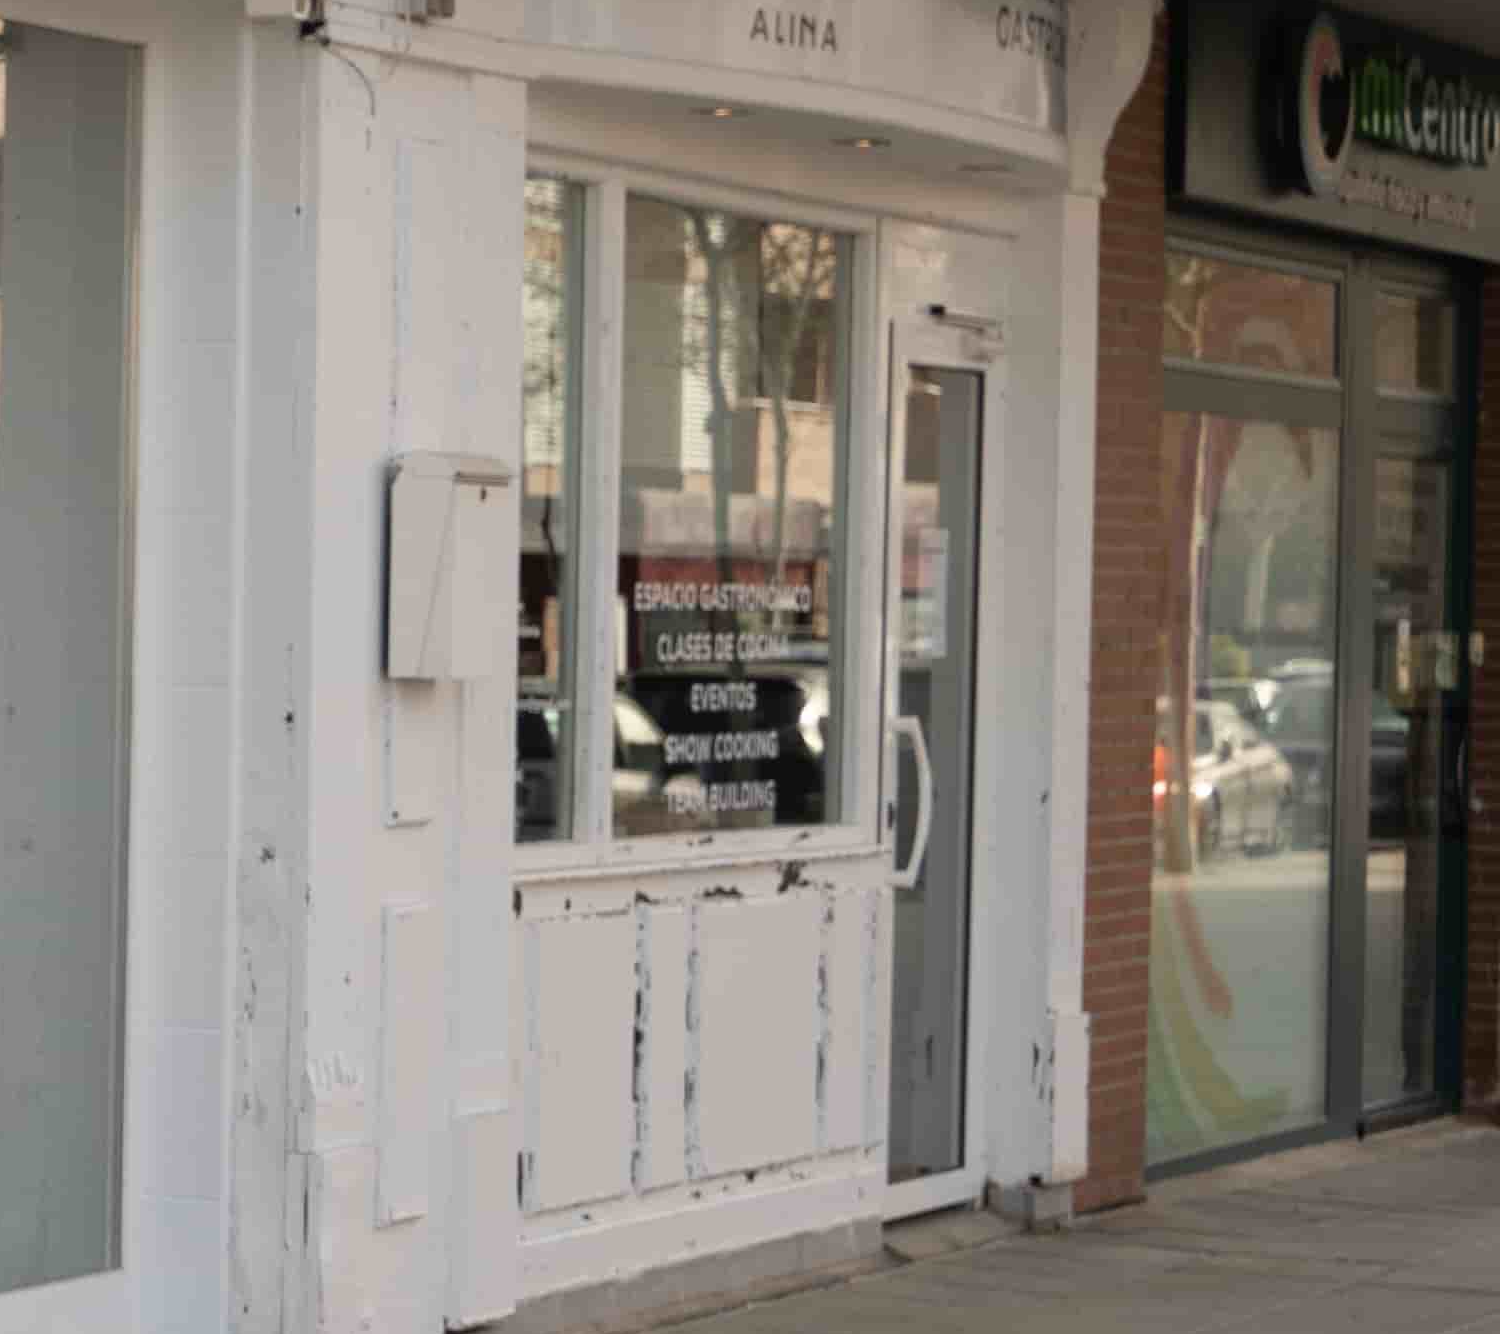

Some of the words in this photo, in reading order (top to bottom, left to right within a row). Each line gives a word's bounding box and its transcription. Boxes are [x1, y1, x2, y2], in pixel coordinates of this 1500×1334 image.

[749, 7, 838, 54] ALINA
[633, 581, 696, 612] ESPACIO
[656, 631, 713, 663] CLASES
[714, 631, 735, 663] DE
[690, 682, 757, 713] EVENTOS
[665, 733, 712, 764] SHOW
[714, 730, 779, 761] COOKING
[709, 778, 776, 812] BUILDING
